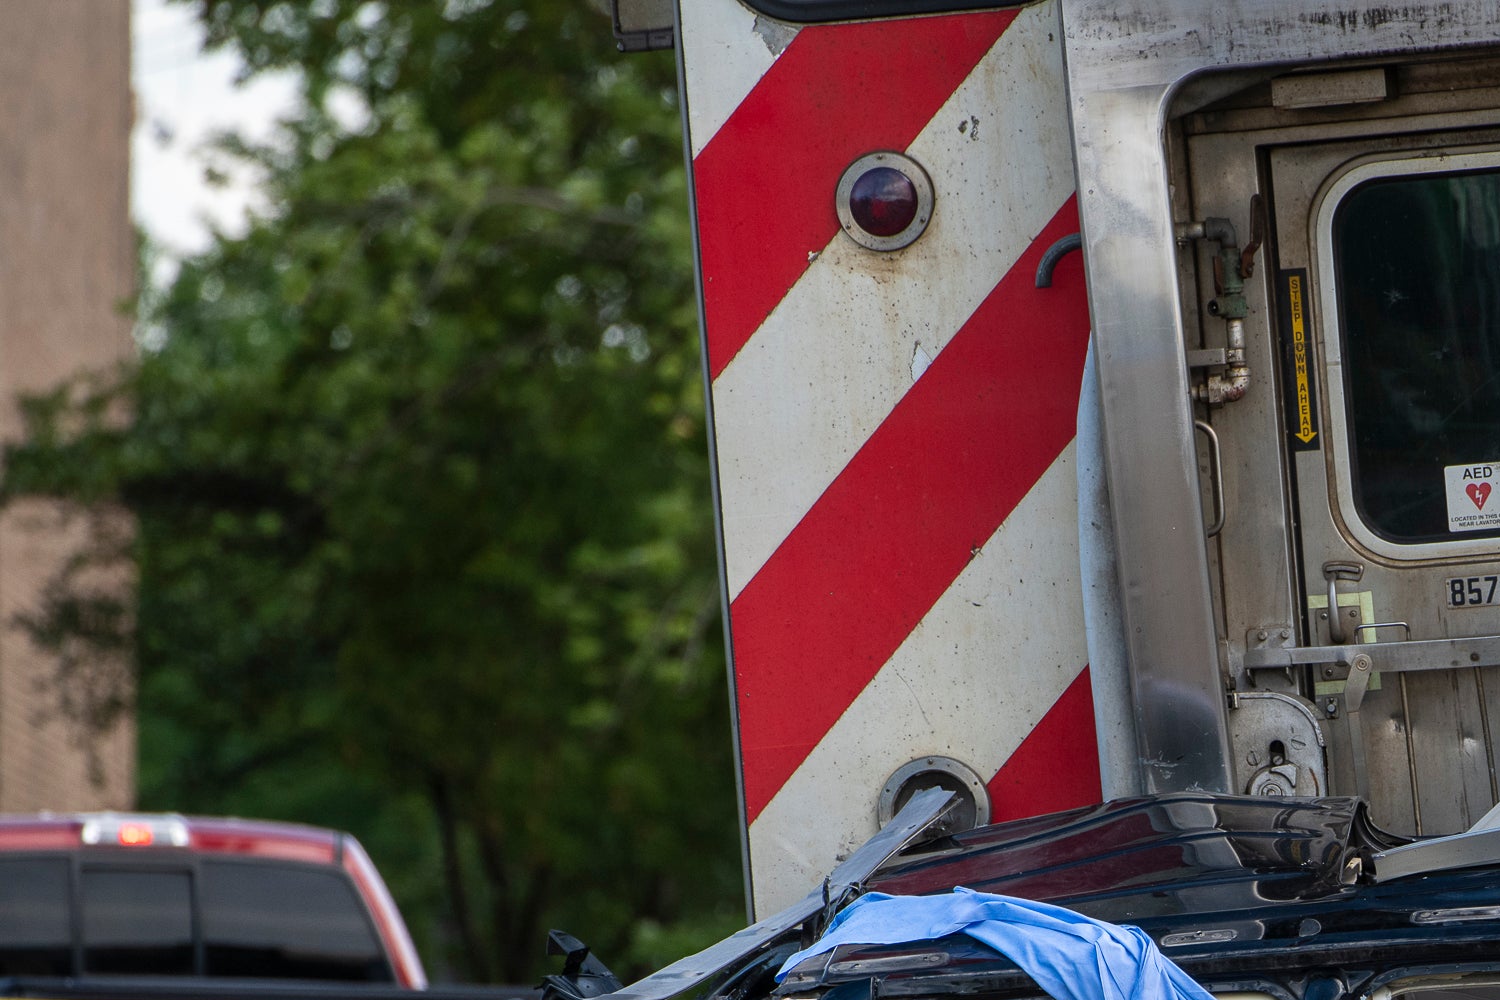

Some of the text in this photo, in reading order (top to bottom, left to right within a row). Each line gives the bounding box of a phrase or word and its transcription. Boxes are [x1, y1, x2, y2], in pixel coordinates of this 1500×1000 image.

[1290, 279, 1310, 438] STEP DOWN AHEAD
[1462, 466, 1493, 480] AED
[1451, 515, 1478, 523] LOCATED
